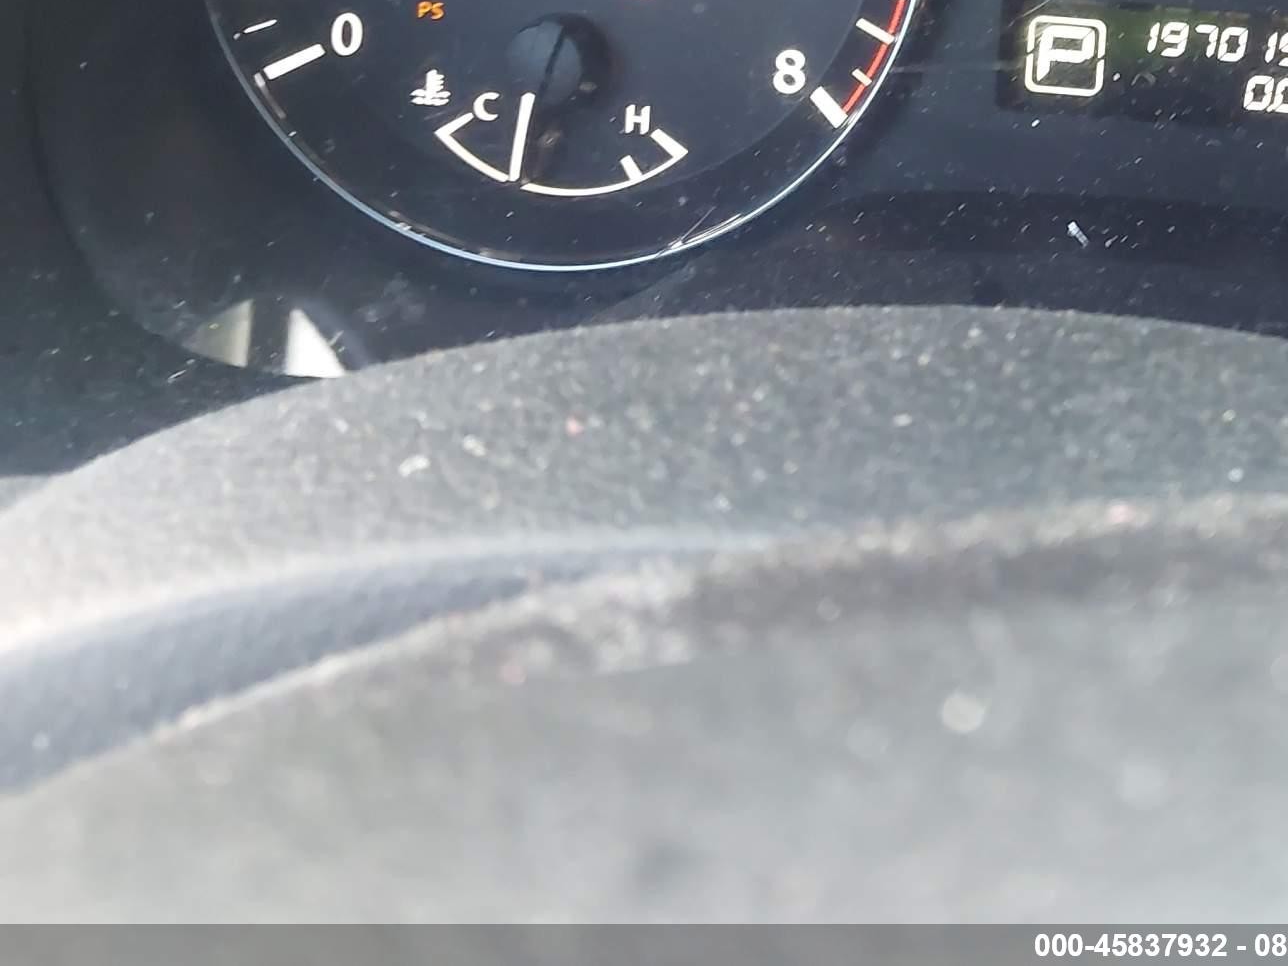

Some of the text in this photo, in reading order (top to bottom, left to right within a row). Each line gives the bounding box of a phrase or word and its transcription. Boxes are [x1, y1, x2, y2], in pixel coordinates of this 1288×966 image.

[416, 1, 446, 20] PS
[331, 12, 363, 56] 0
[773, 49, 806, 95] 8
[1036, 26, 1097, 82] P
[472, 92, 500, 122] C
[624, 104, 652, 134] H
